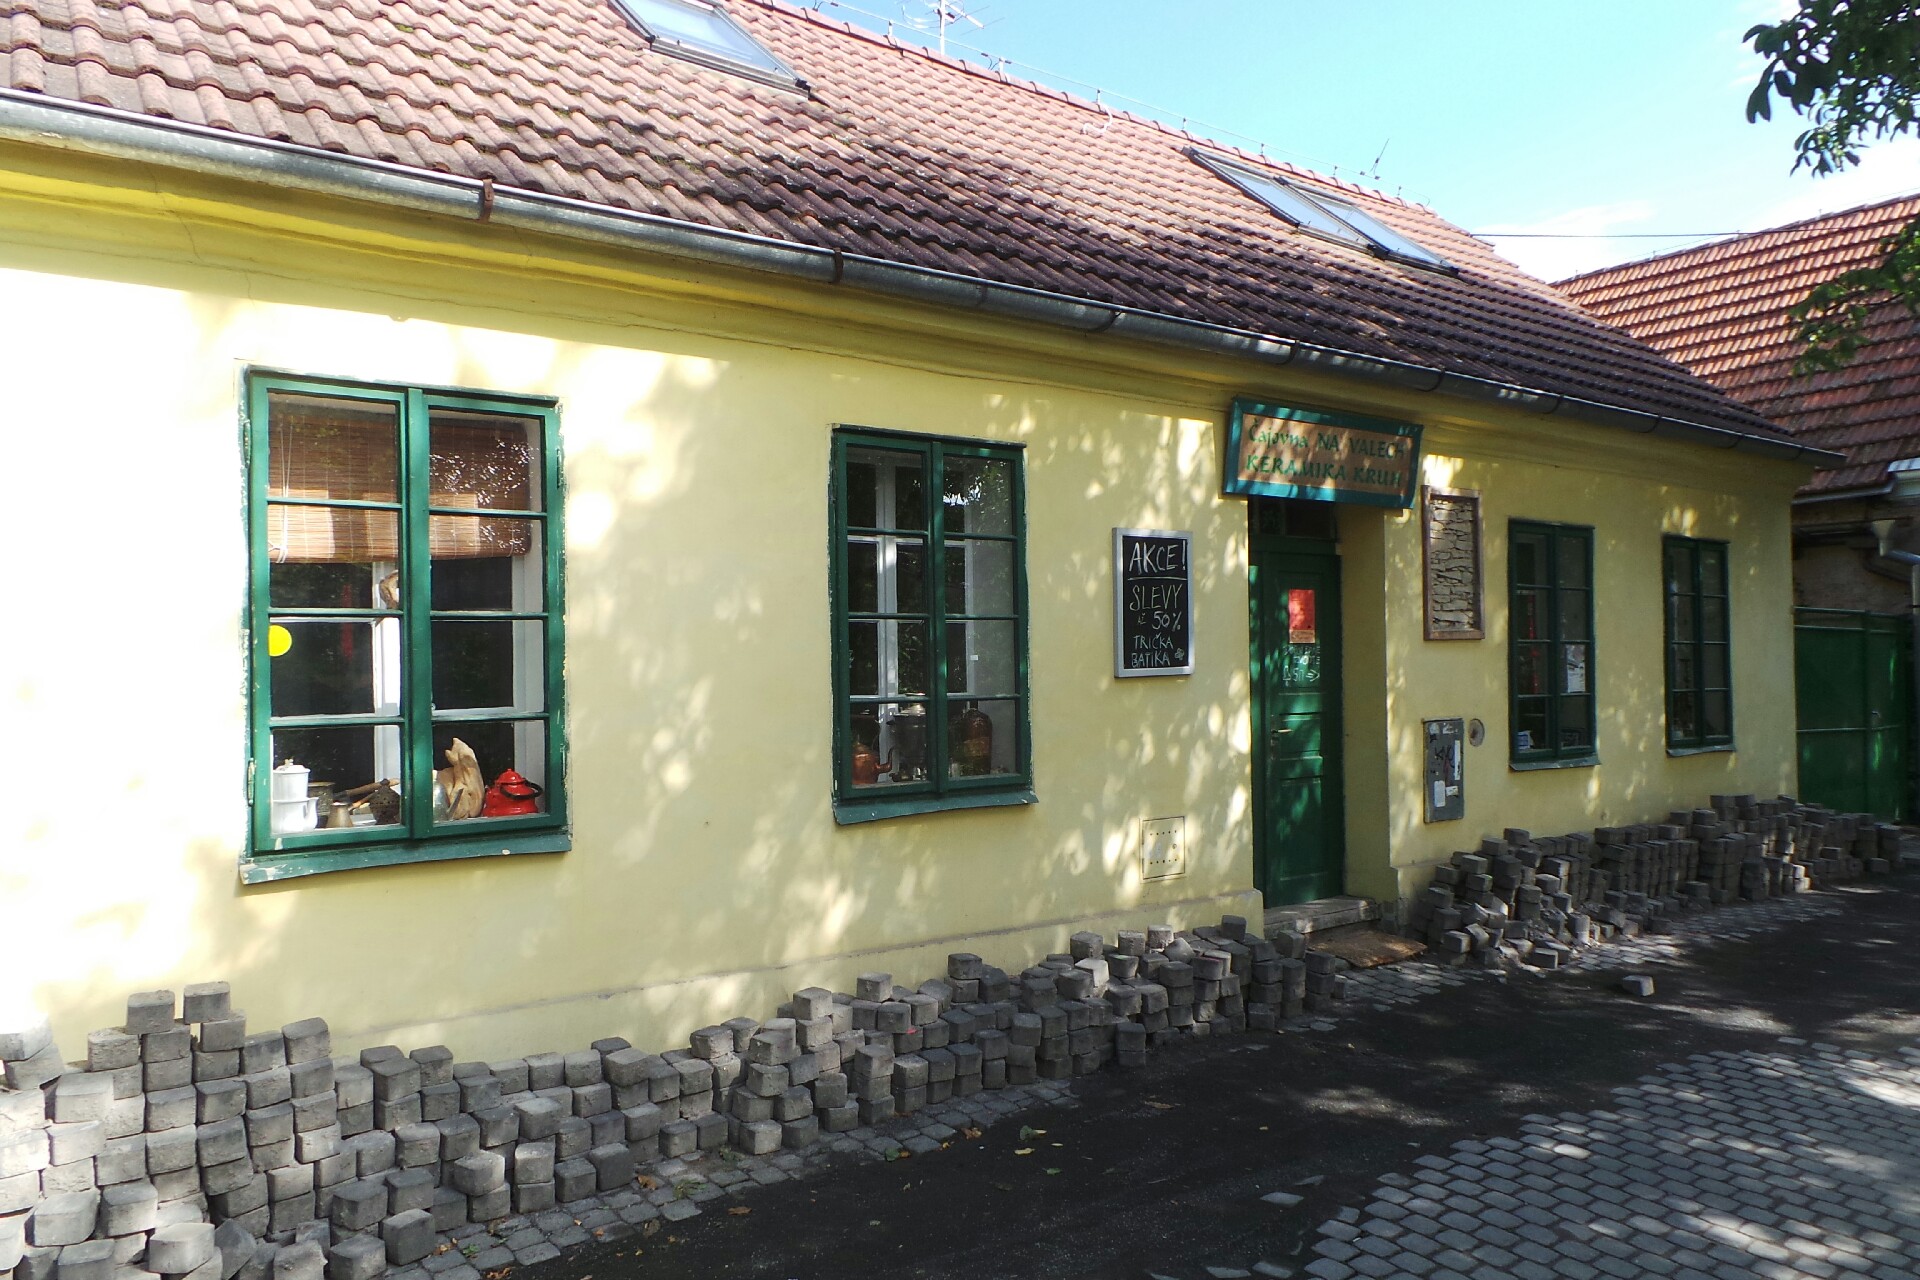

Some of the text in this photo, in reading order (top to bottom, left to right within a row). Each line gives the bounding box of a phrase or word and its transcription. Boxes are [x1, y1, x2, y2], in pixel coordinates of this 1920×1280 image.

[1317, 432, 1340, 452] NA
[1245, 454, 1346, 481] KERAMIKA
[1128, 540, 1187, 575] AKCE!
[1129, 583, 1183, 612] SLEVY
[1133, 632, 1174, 650] TRIČKA
[1131, 650, 1171, 668] BATIKA
